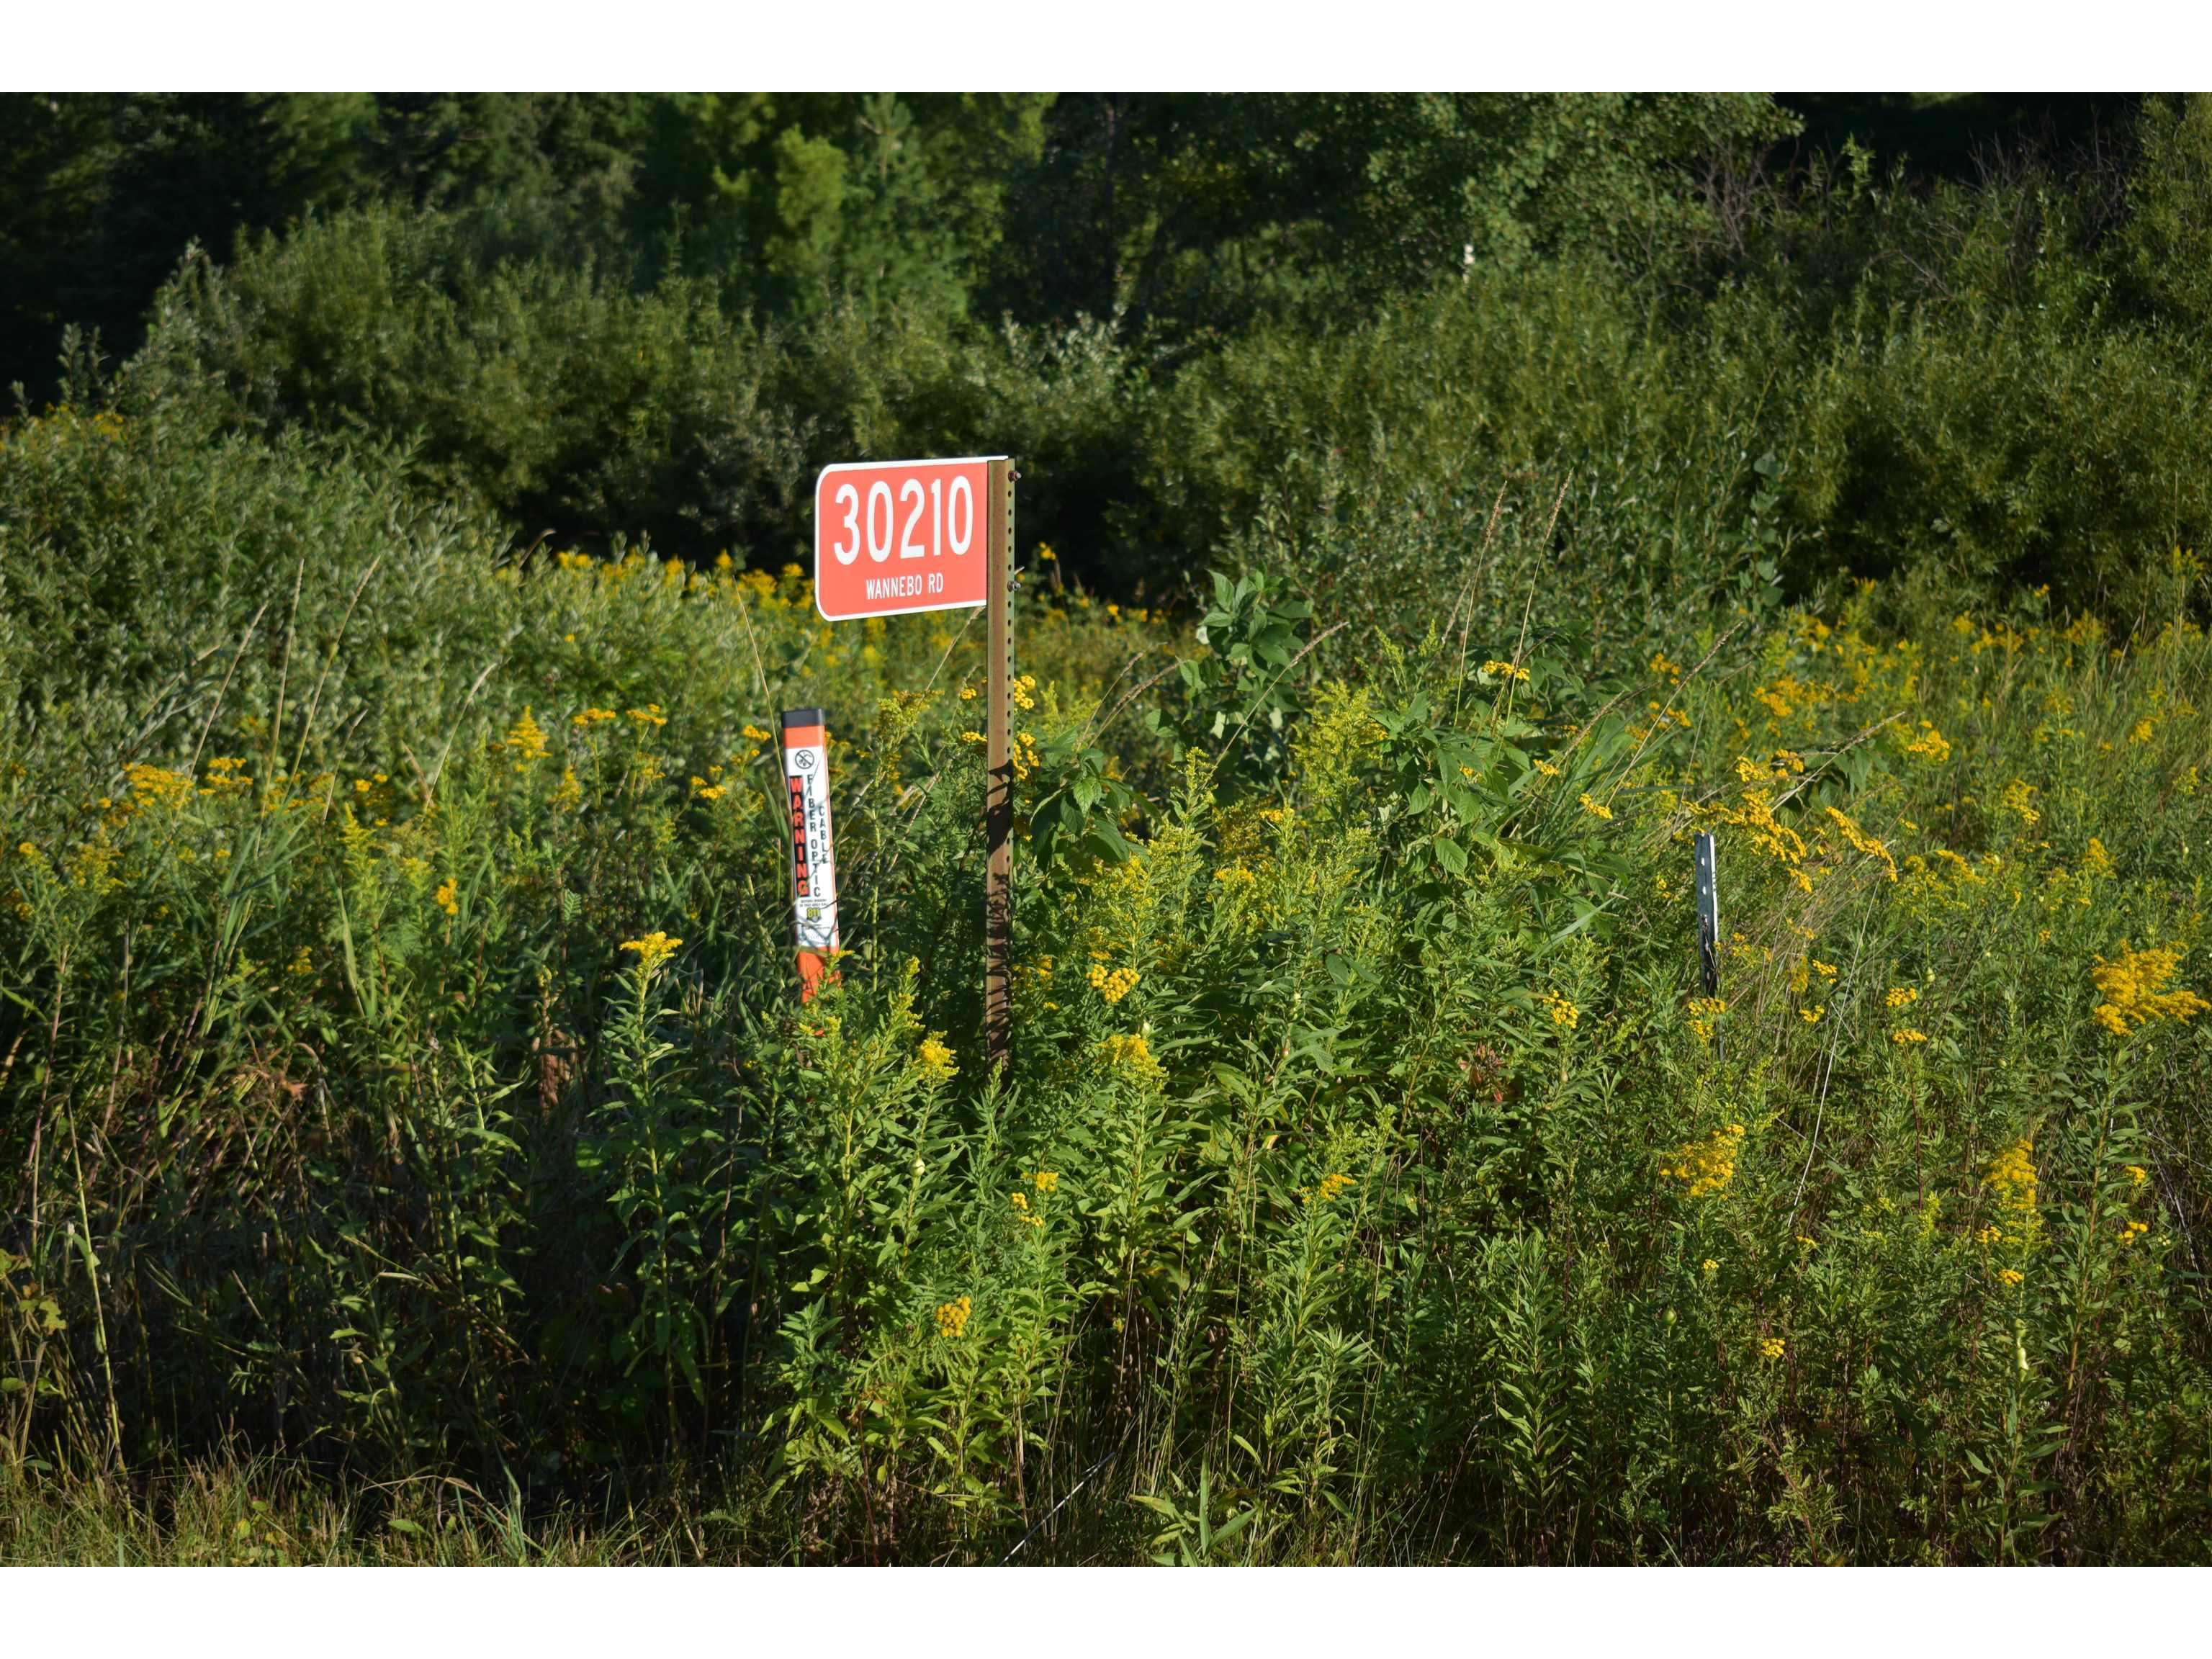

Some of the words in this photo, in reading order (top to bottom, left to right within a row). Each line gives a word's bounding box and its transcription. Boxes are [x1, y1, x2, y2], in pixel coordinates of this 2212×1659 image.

[834, 475, 974, 565] 30210
[866, 575, 922, 600] WANNEBO
[928, 572, 944, 593] RD
[807, 774, 817, 832] FIBER
[790, 777, 809, 896] WARNING
[819, 806, 829, 864] CABLE
[811, 839, 821, 897] OPTIC
[807, 908, 819, 917] 811
